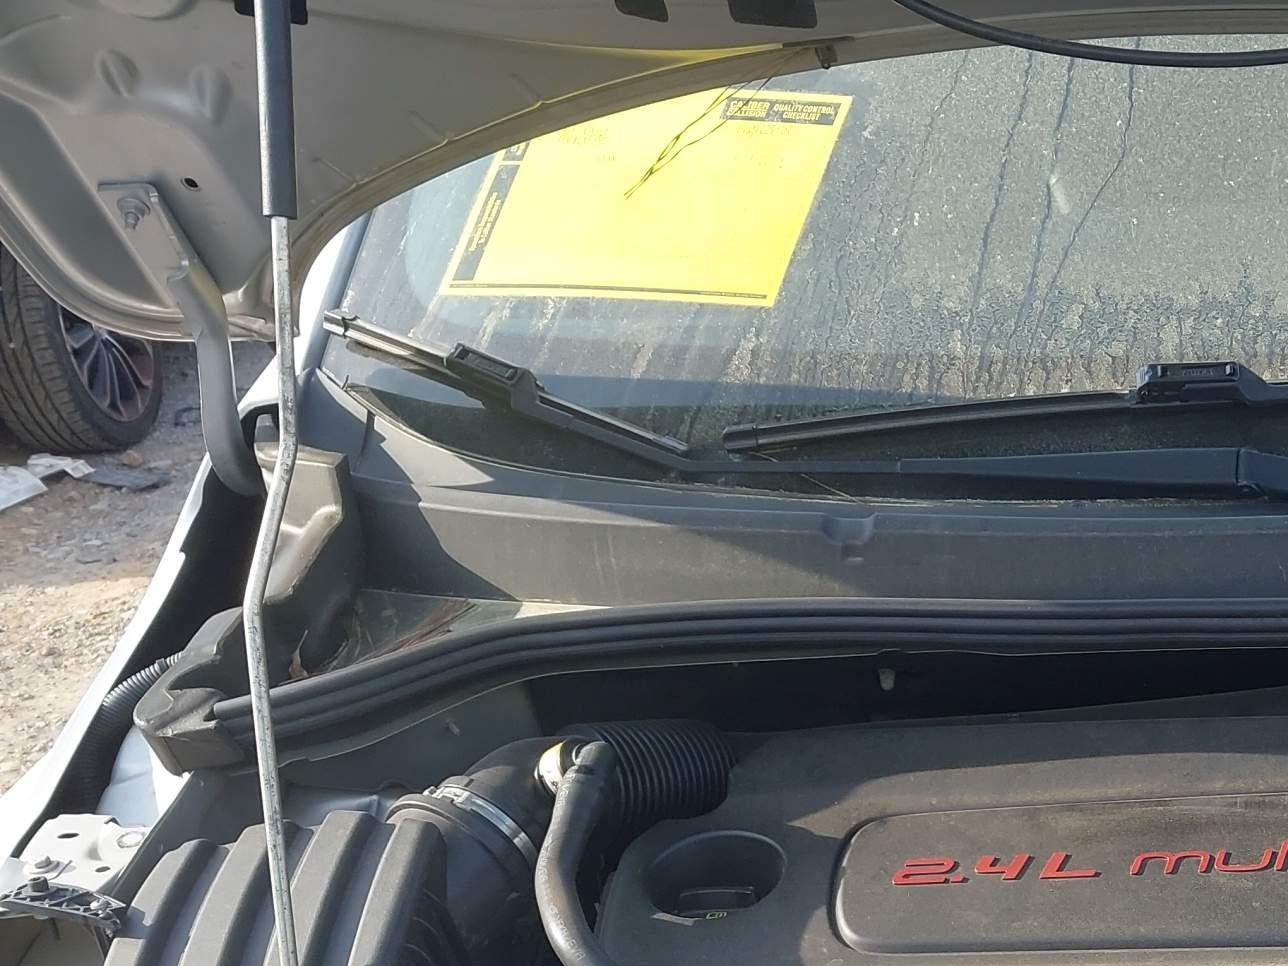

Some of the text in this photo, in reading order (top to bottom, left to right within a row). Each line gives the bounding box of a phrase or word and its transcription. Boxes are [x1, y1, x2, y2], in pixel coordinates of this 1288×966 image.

[774, 103, 835, 115] QUALITY CONTROL
[782, 111, 821, 121] CHECKLIST
